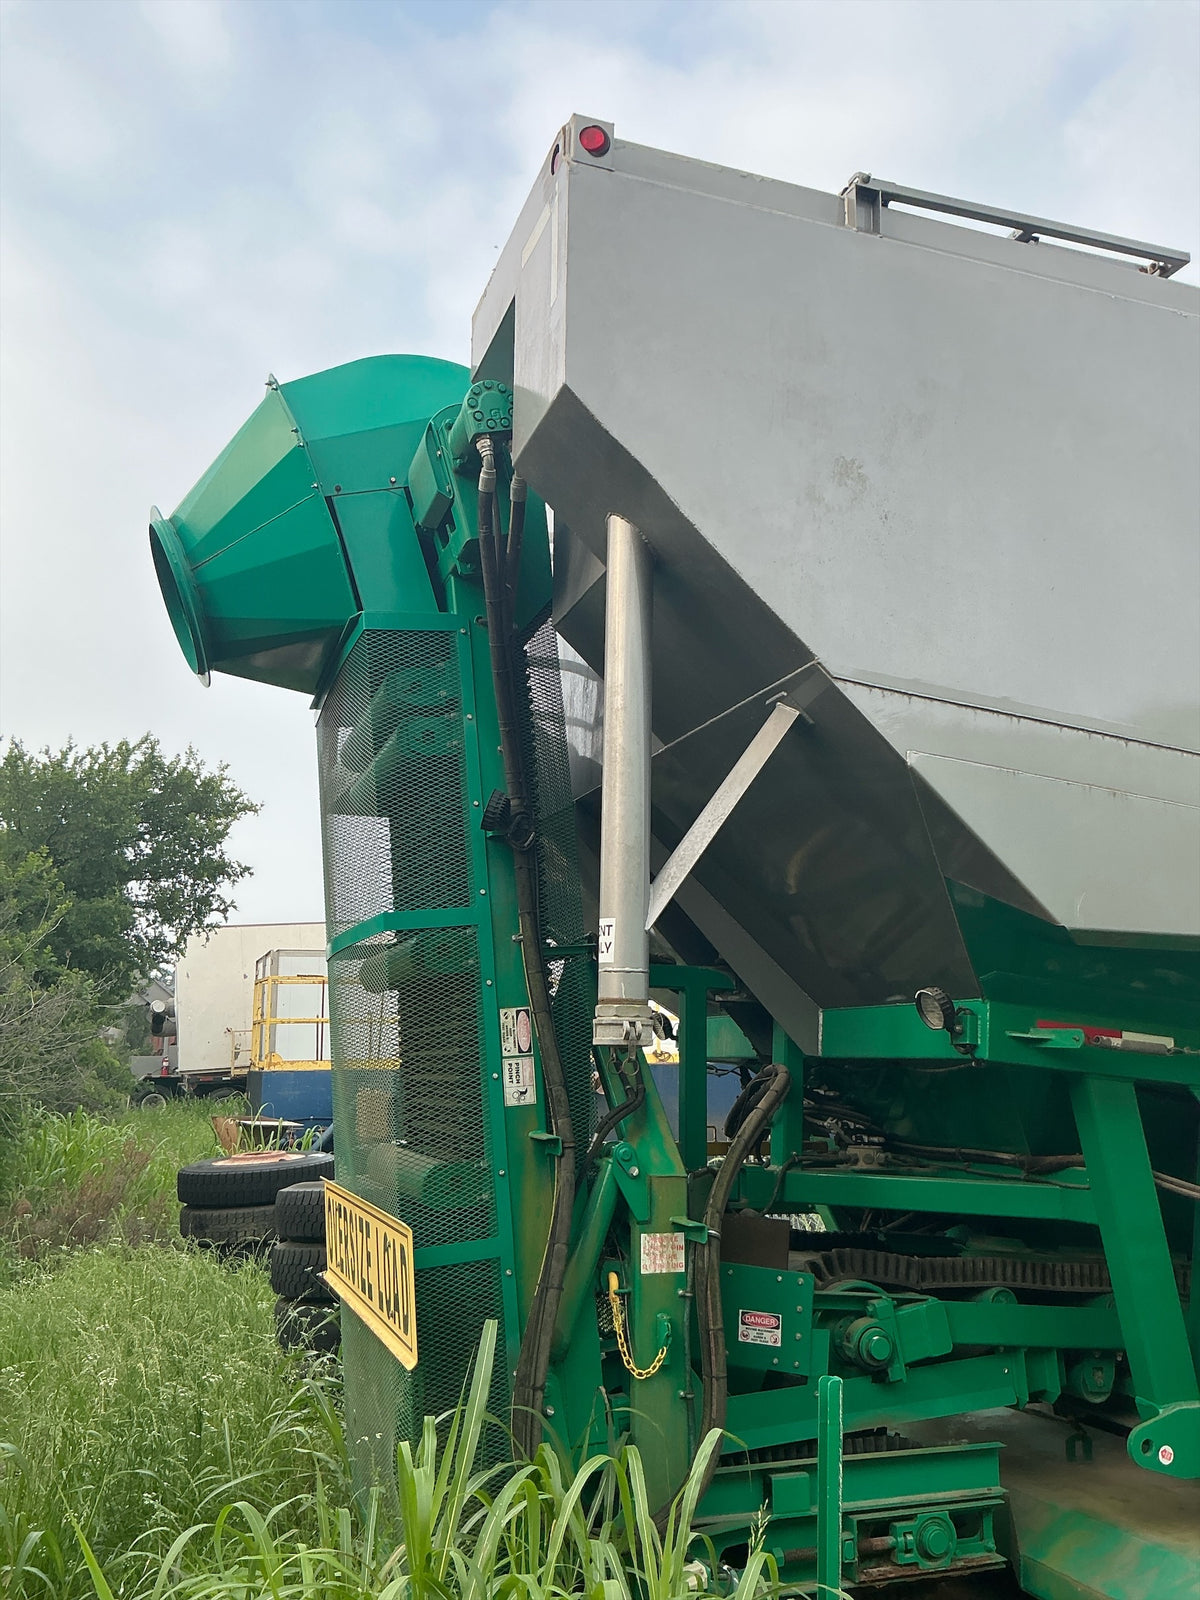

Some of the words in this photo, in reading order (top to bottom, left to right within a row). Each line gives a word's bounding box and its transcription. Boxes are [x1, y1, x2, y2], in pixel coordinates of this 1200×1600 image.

[328, 1196, 373, 1302] OVERSIZE
[376, 1227, 410, 1336] LOAD
[745, 1315, 776, 1326] DANGER
